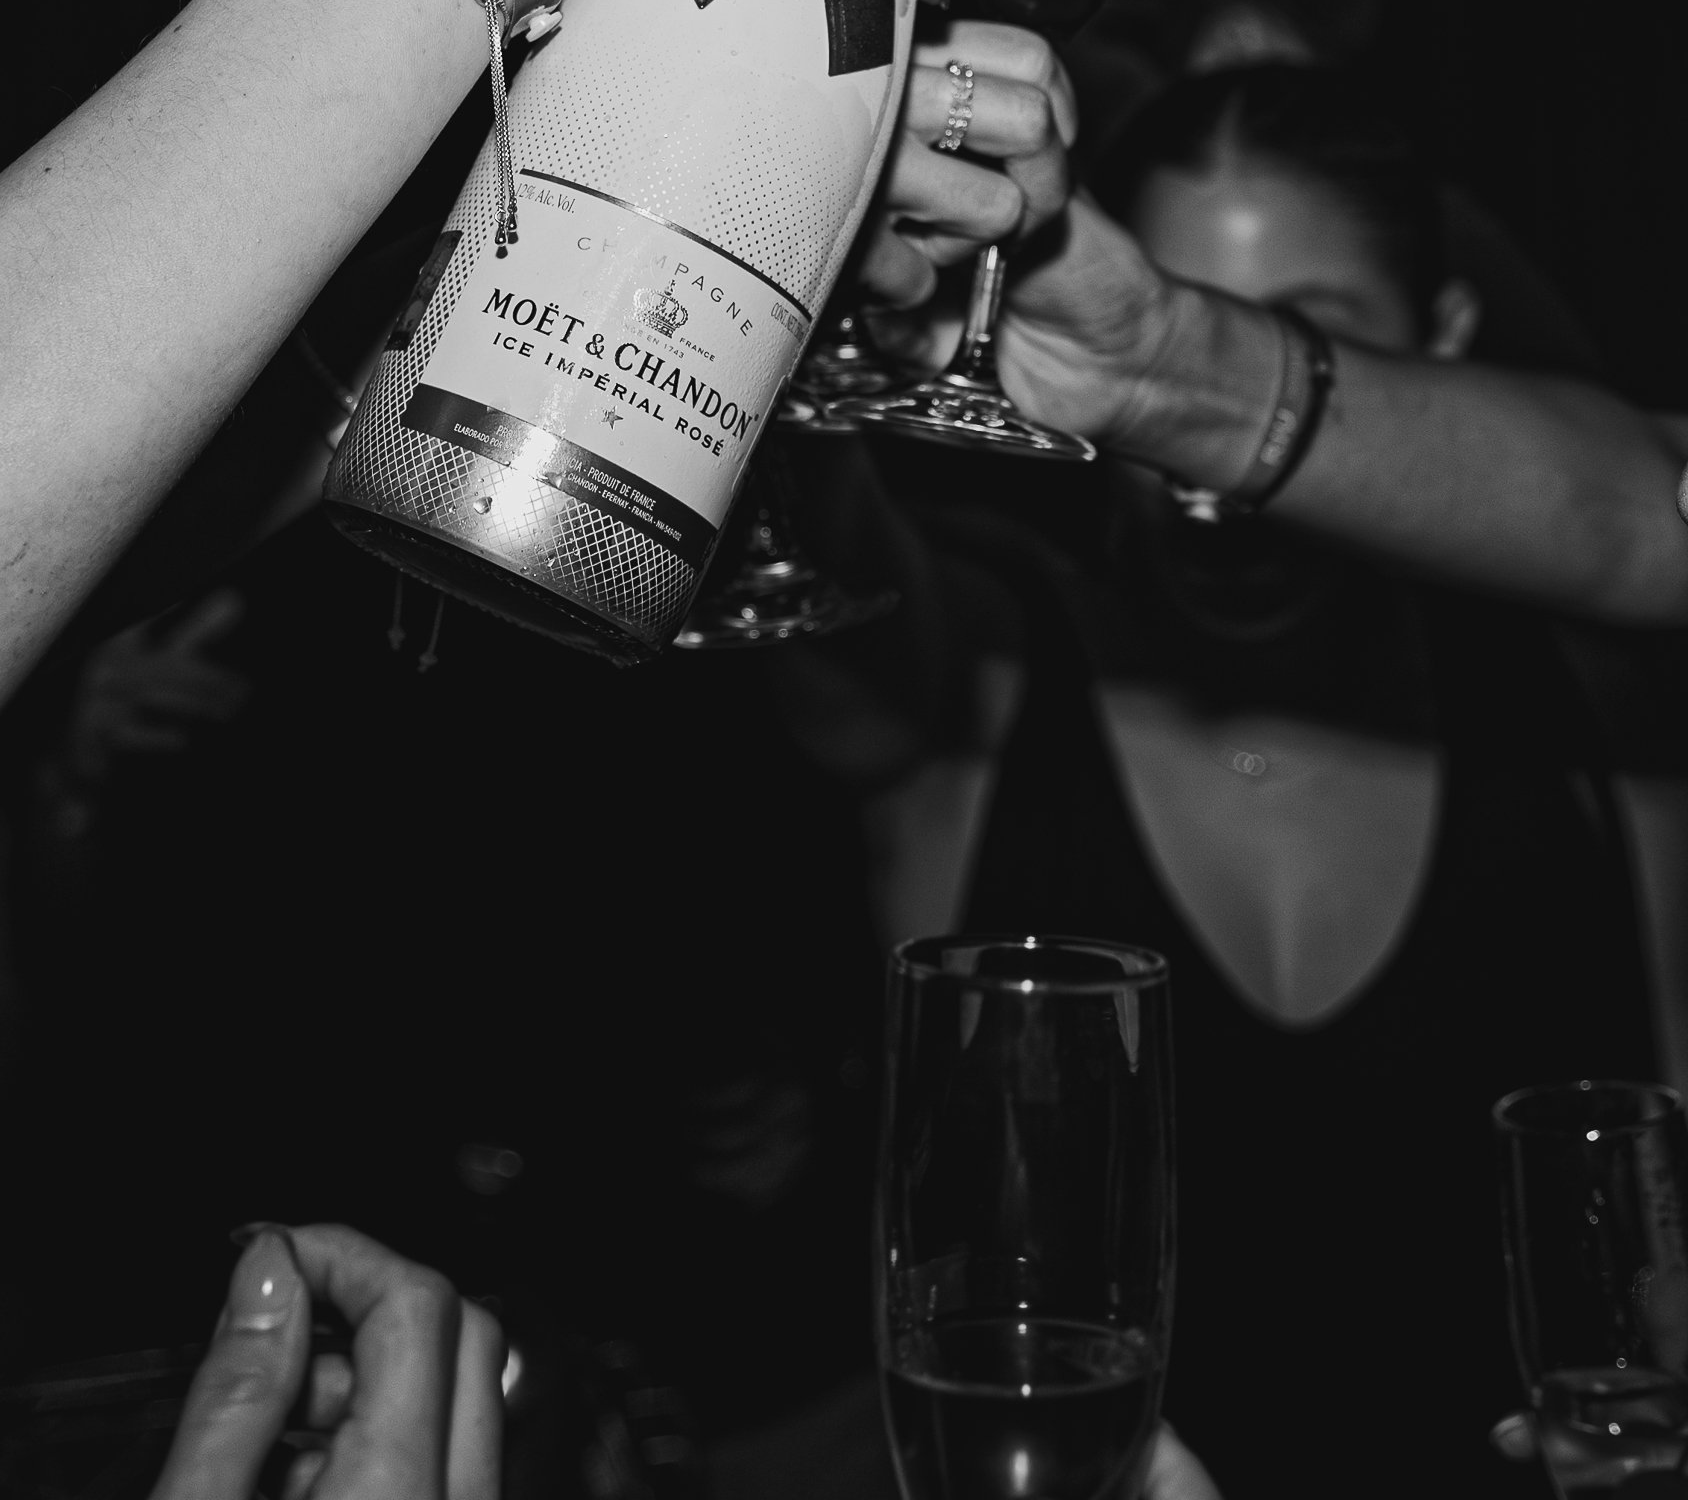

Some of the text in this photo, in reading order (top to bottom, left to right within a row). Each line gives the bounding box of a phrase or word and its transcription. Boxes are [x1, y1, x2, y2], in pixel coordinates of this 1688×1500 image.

[534, 189, 555, 207] Alc.
[557, 193, 576, 214] Vol.
[577, 236, 753, 337] CHMPAGNE
[481, 287, 753, 442] MOËT & CHANDON
[663, 343, 685, 359] 1743
[679, 337, 716, 362] FRANCE
[492, 332, 725, 457] ICE IMPÉRIAL ROSÉ
[453, 423, 490, 444] ELABORADO
[567, 472, 600, 493] CHANDON
[601, 489, 630, 510] EPERNAY
[631, 505, 655, 524] FRANCIA
[587, 466, 622, 491] PRODUIT
[619, 483, 632, 497] DE
[629, 489, 657, 511] FRANCE
